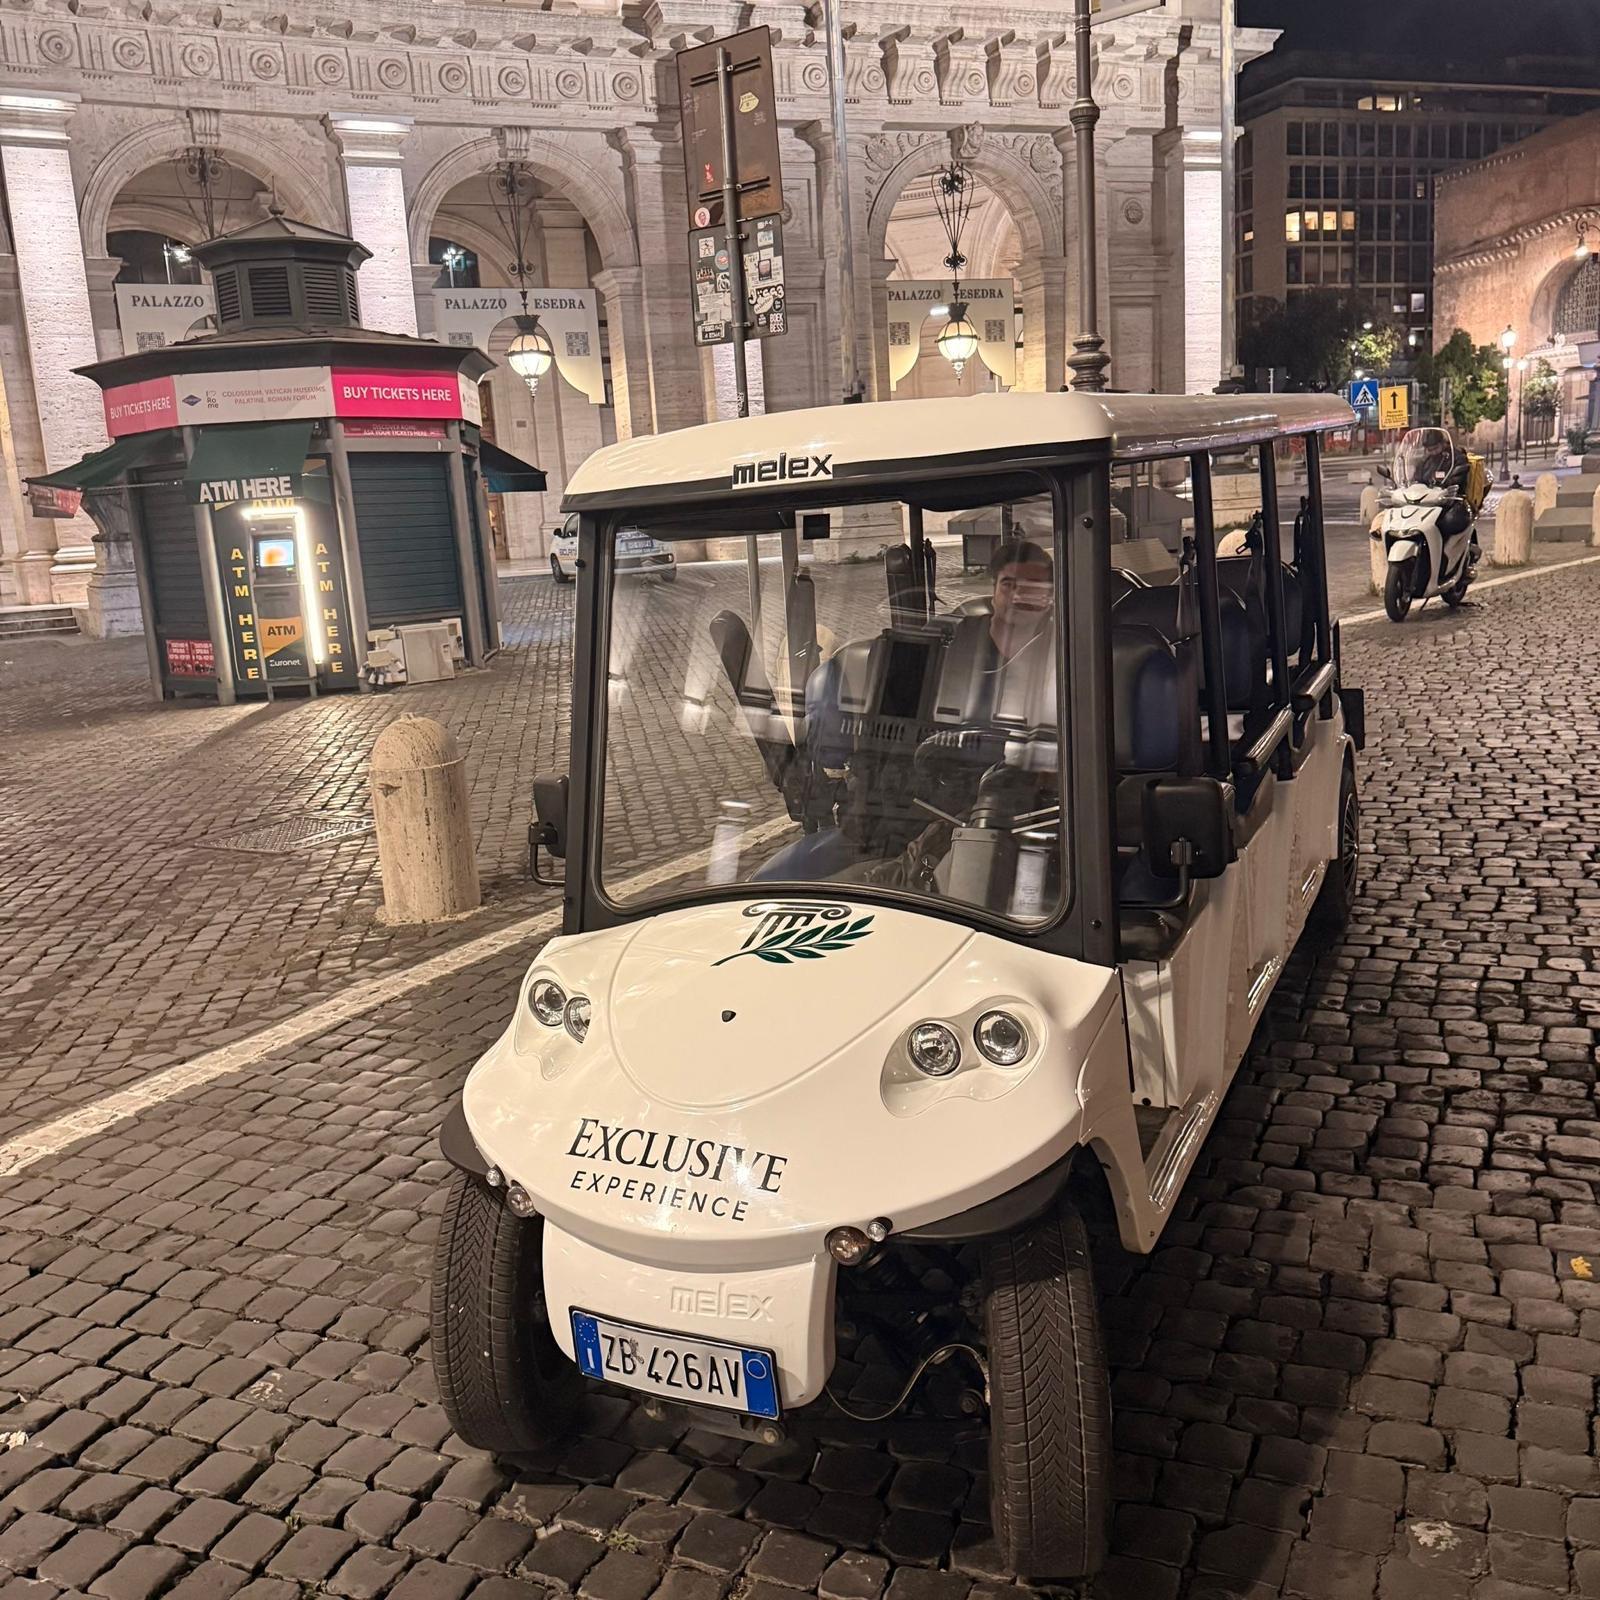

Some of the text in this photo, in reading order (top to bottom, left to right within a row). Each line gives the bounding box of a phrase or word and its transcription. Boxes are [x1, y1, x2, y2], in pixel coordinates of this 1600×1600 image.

[132, 295, 204, 307] PALAZZO
[445, 299, 586, 310] PALAZZO ESEDRA
[889, 288, 1004, 301] PALAZZO ESEDRA
[264, 387, 292, 396] VATICAN
[268, 395, 292, 403] ROMAN
[293, 393, 317, 401] FORUM
[343, 386, 452, 401] BUY TICKETS HERE
[110, 406, 123, 419] BUY
[123, 400, 151, 417] TICKETS
[152, 396, 171, 412] HERE
[733, 452, 833, 485] melex
[199, 476, 293, 503] ATM HERE
[230, 547, 259, 680] ATM HERE
[315, 542, 344, 674] ATM HERE
[267, 624, 296, 637] ATM
[565, 1117, 788, 1193] EXCLUSIVE
[570, 1170, 749, 1222] EXPERIENCE
[671, 1282, 775, 1322] melex
[601, 1333, 638, 1376] ZB
[646, 1346, 740, 1398] 426AV
